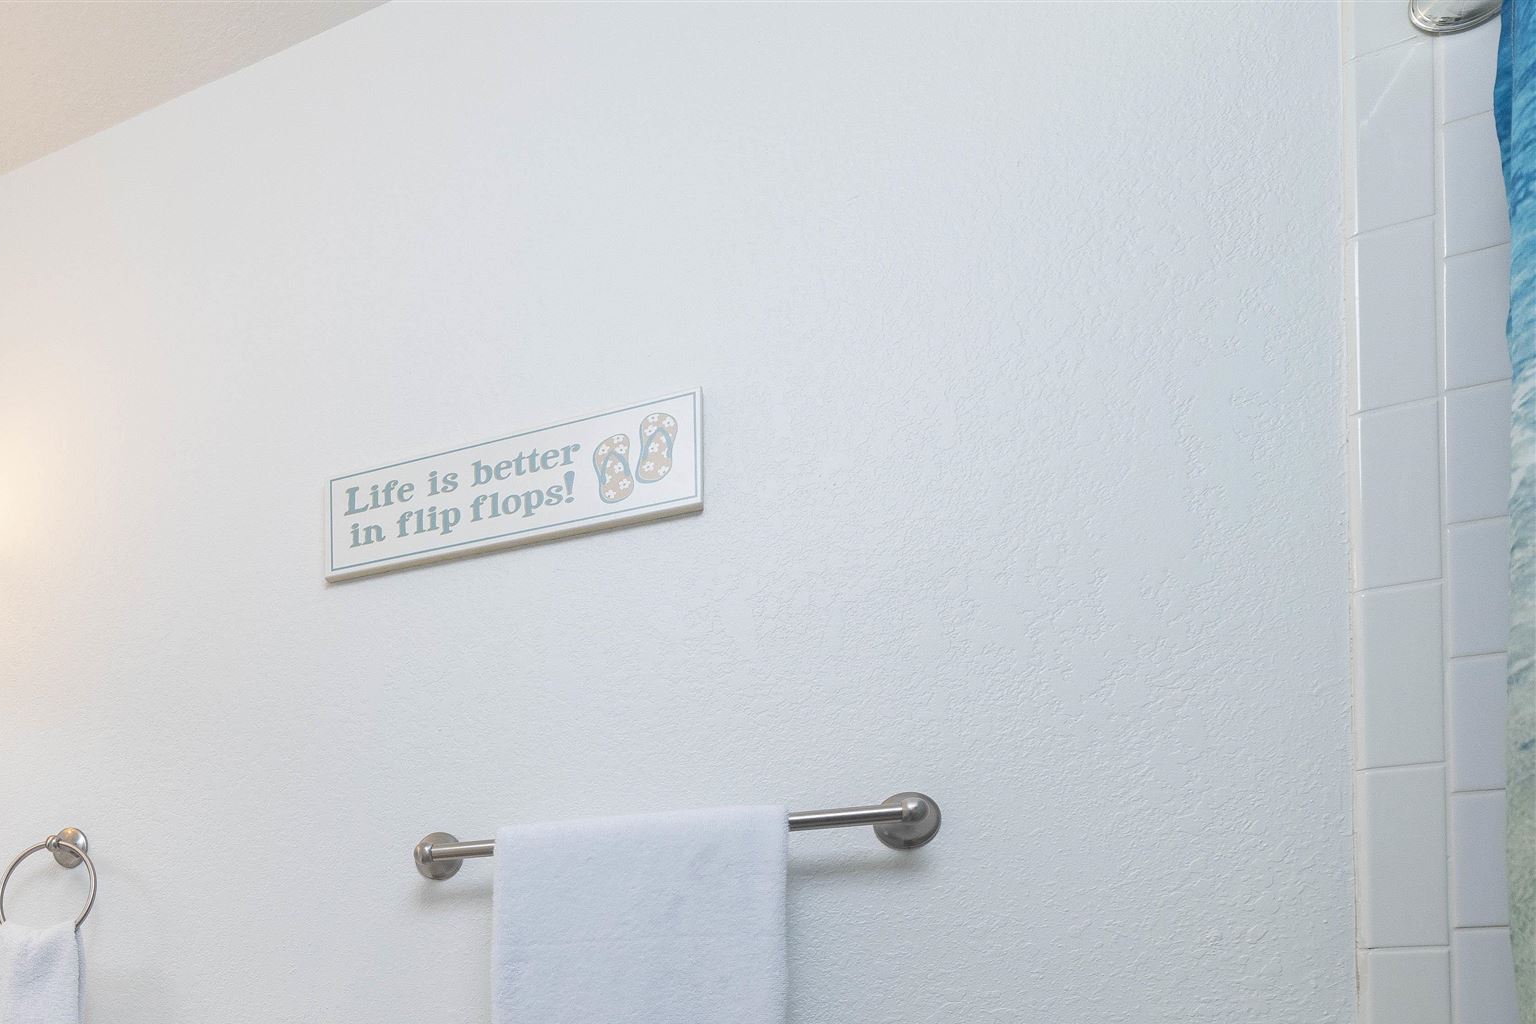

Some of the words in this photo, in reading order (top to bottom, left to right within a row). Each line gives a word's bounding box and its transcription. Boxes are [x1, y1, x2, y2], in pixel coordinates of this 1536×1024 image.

[343, 478, 414, 517] Life
[427, 470, 459, 498] is
[470, 441, 581, 488] better
[349, 522, 386, 548] in
[396, 505, 461, 538] flip
[470, 470, 577, 523] flops!
